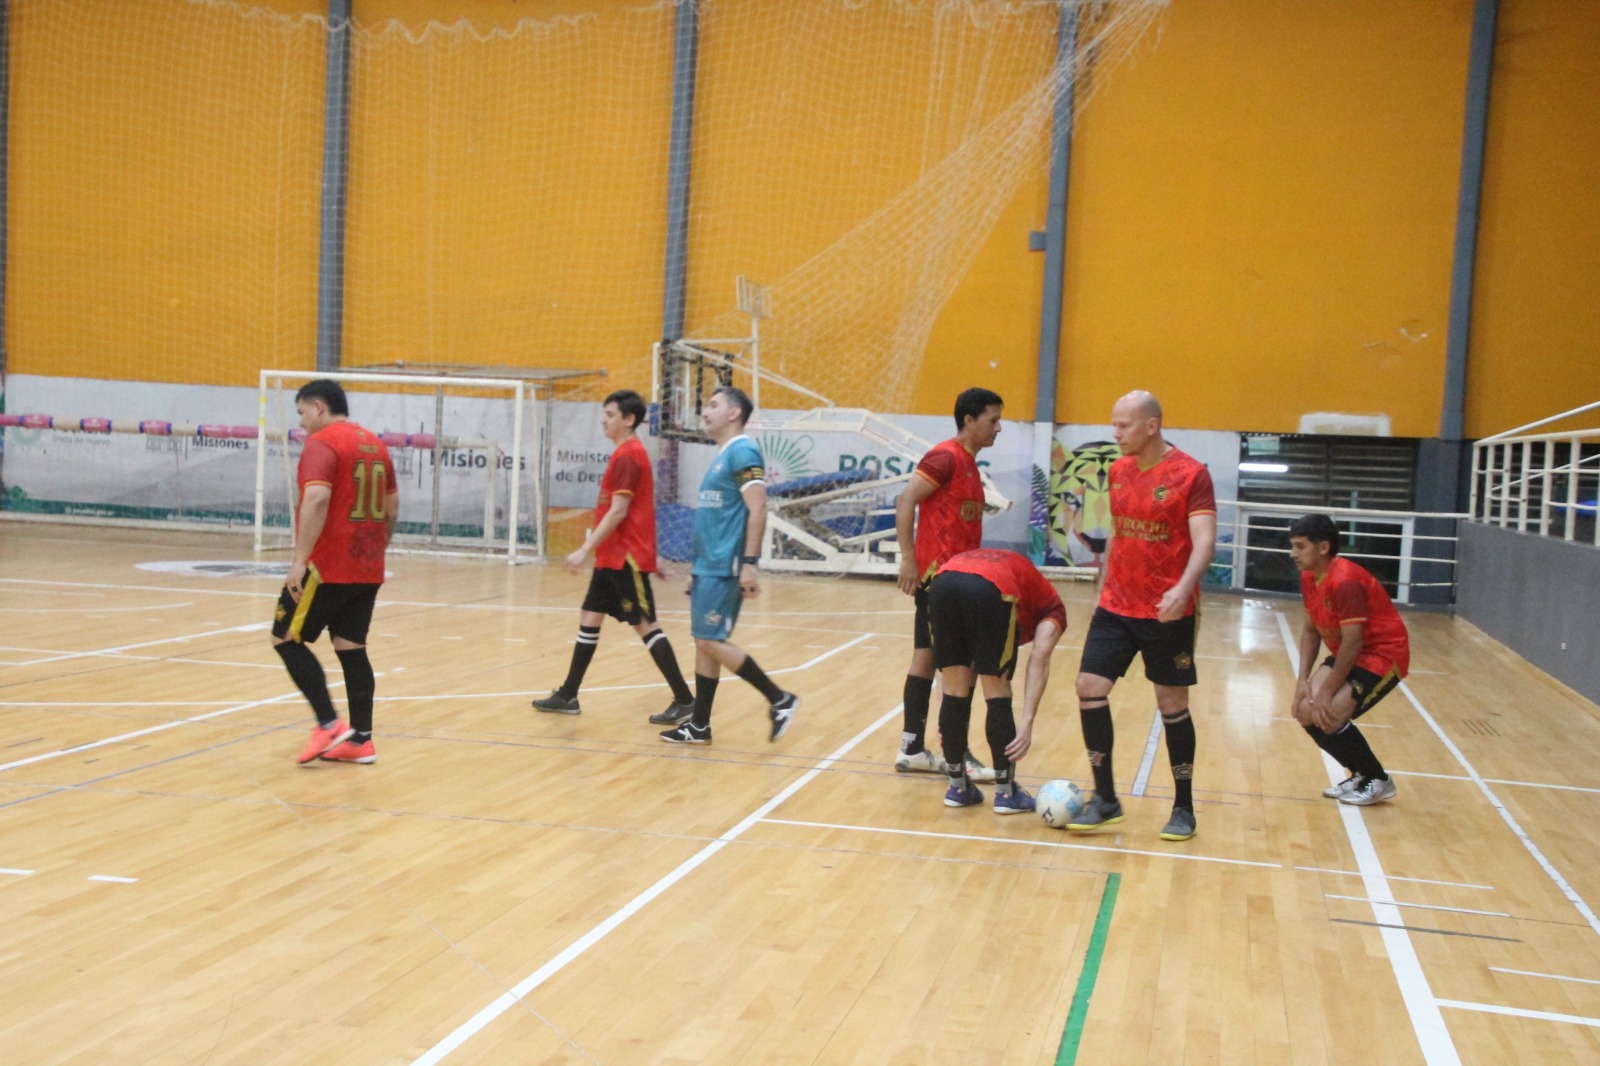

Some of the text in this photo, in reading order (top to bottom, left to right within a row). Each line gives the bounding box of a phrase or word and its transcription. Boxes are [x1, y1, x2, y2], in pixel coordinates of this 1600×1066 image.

[556, 449, 611, 463] Ministe
[577, 470, 605, 487] Dep
[349, 459, 386, 521] 10
